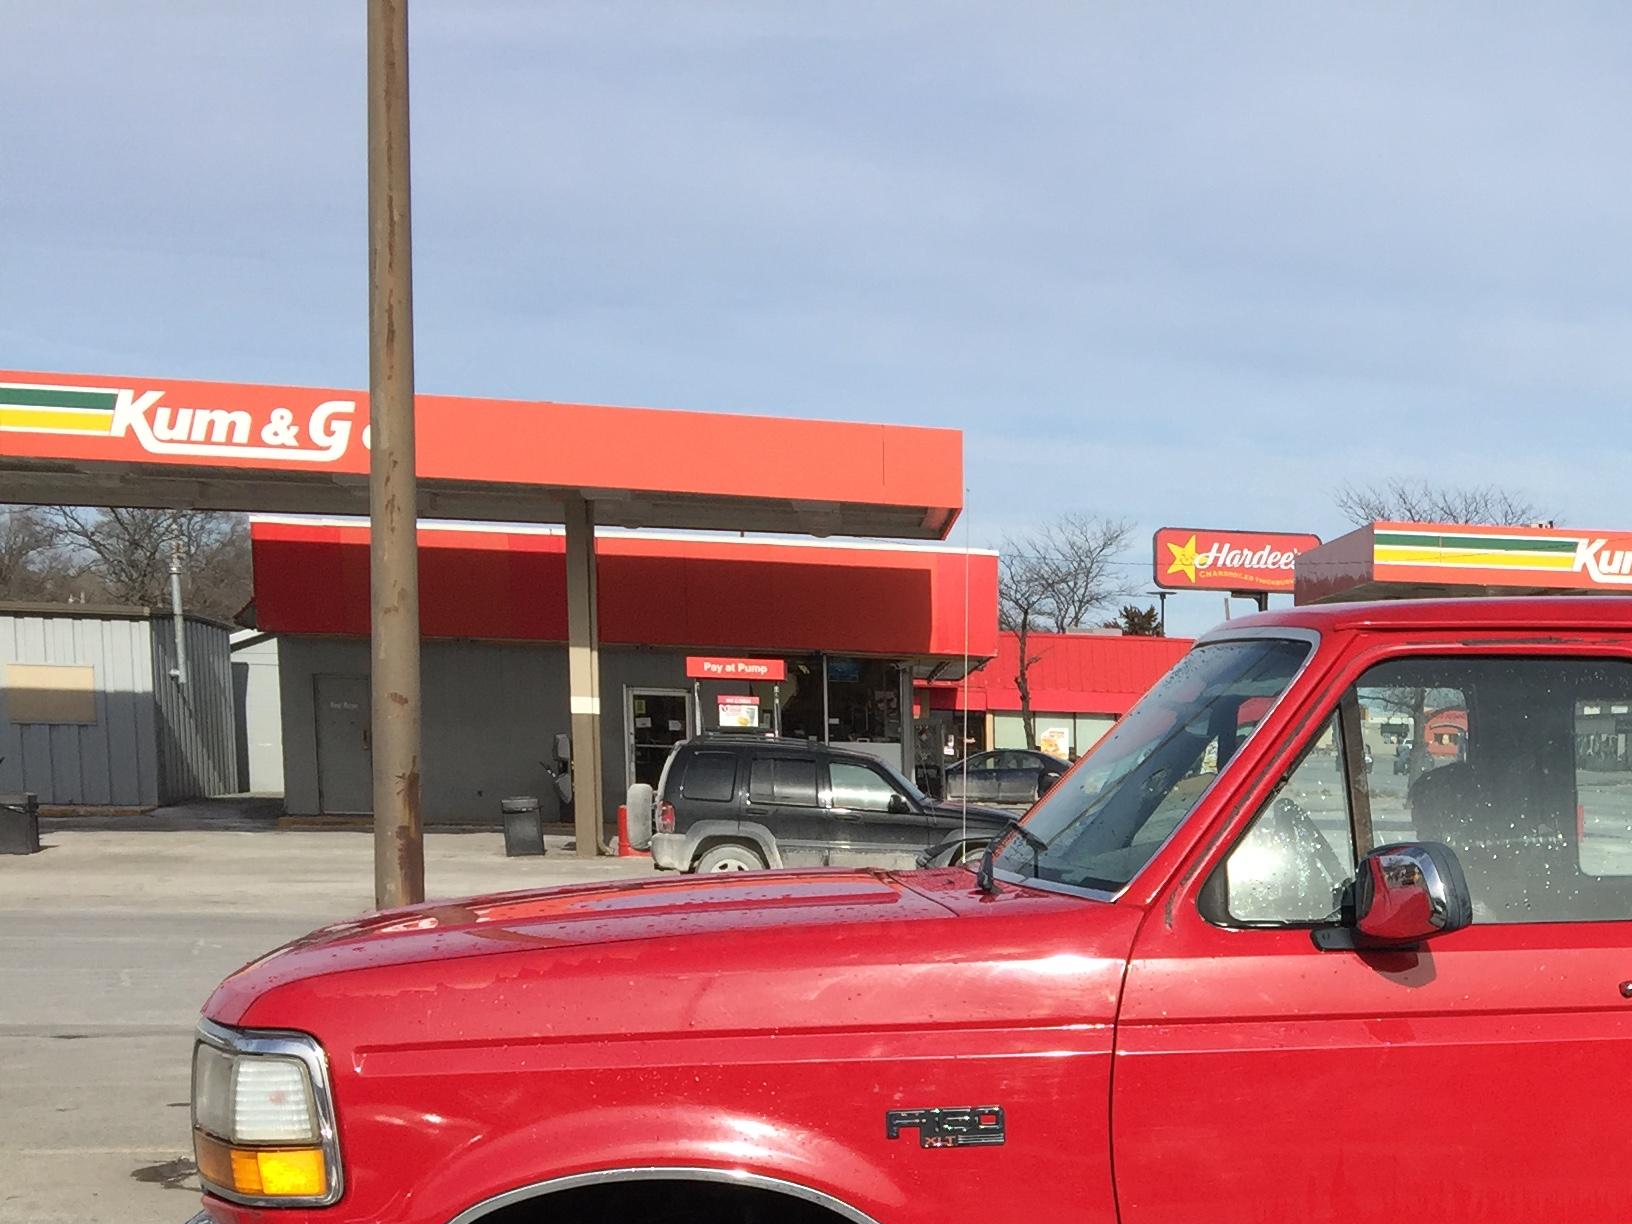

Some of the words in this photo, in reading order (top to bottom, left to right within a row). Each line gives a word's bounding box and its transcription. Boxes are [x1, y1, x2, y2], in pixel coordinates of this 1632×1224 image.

[109, 389, 252, 450] Kum
[260, 407, 300, 447] &
[1194, 542, 1302, 570] Hardee'
[703, 662, 723, 674] Pay
[725, 663, 735, 672] at
[737, 663, 768, 675] Pump
[925, 1135, 956, 1147] XLT
